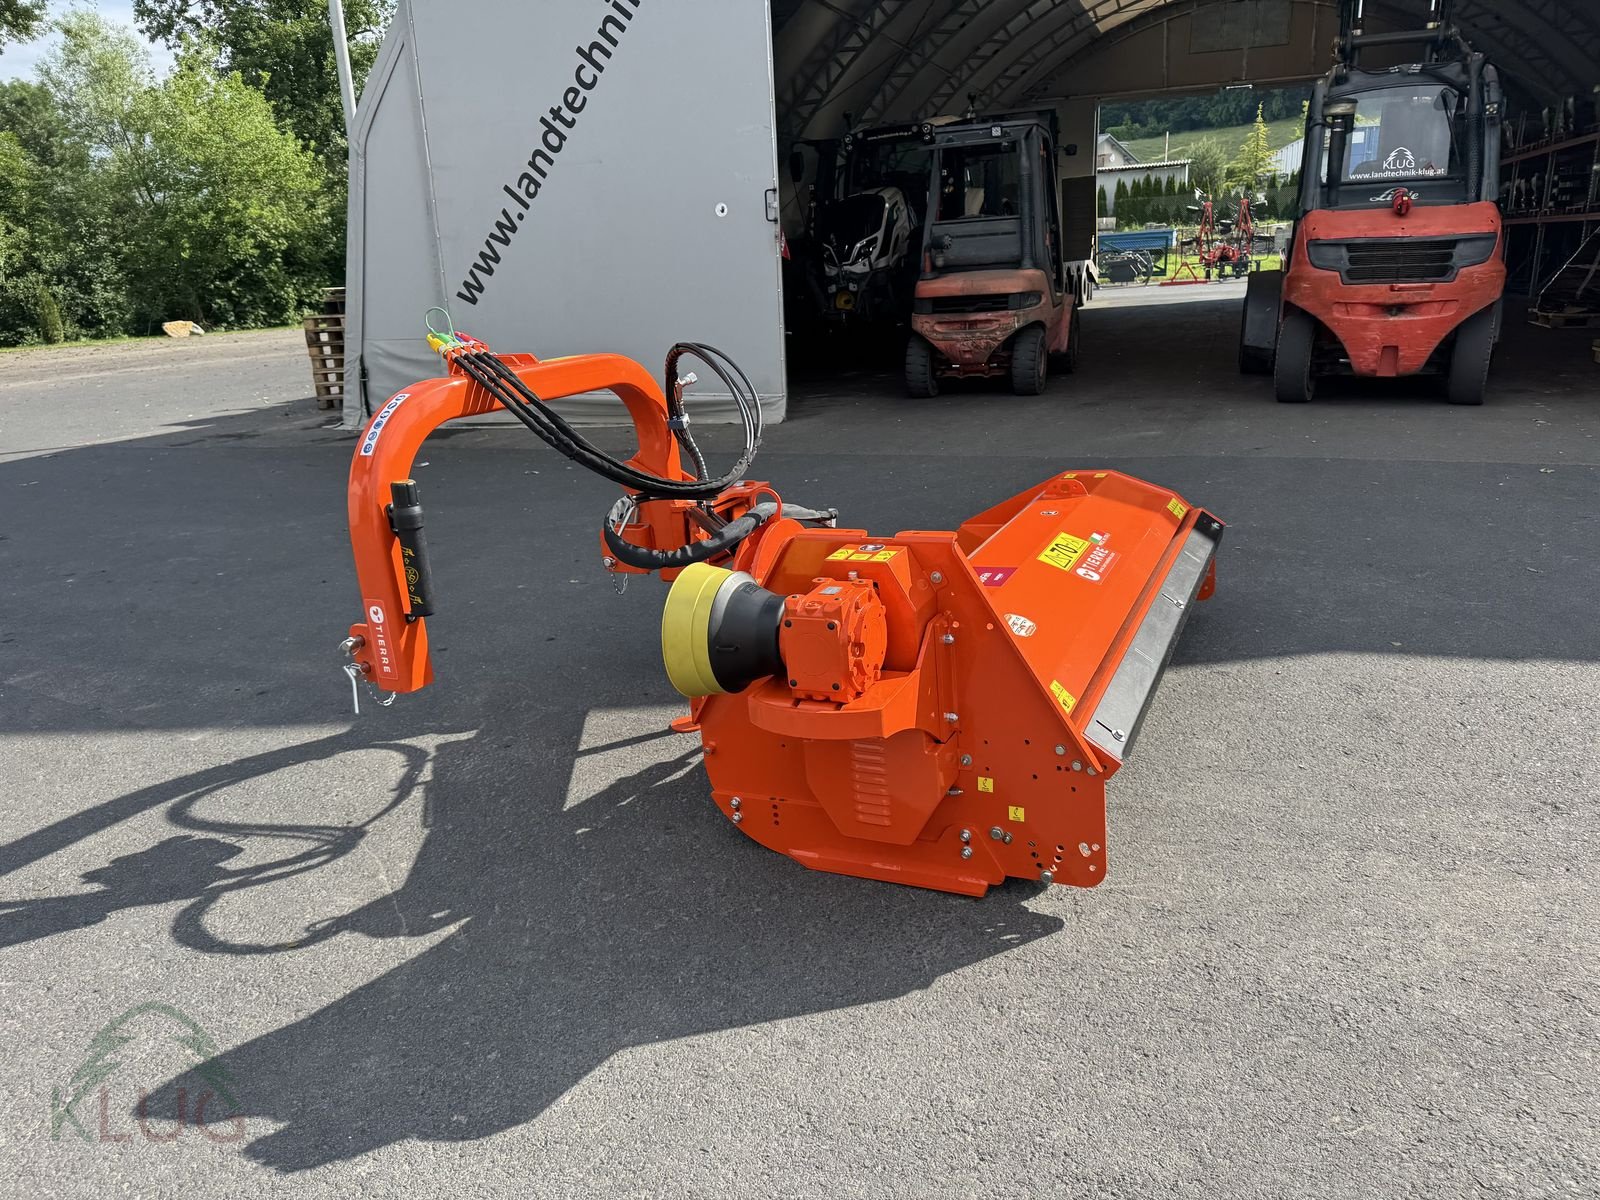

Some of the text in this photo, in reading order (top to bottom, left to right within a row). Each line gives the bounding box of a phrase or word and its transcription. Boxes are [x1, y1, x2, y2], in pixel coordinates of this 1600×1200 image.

[456, 0, 640, 305] www.landtechni
[1383, 160, 1415, 169] KLUG
[1349, 168, 1445, 180] www.landtechnik-klug.at
[1082, 546, 1109, 571] TIERRE
[376, 625, 391, 673] TIERRE
